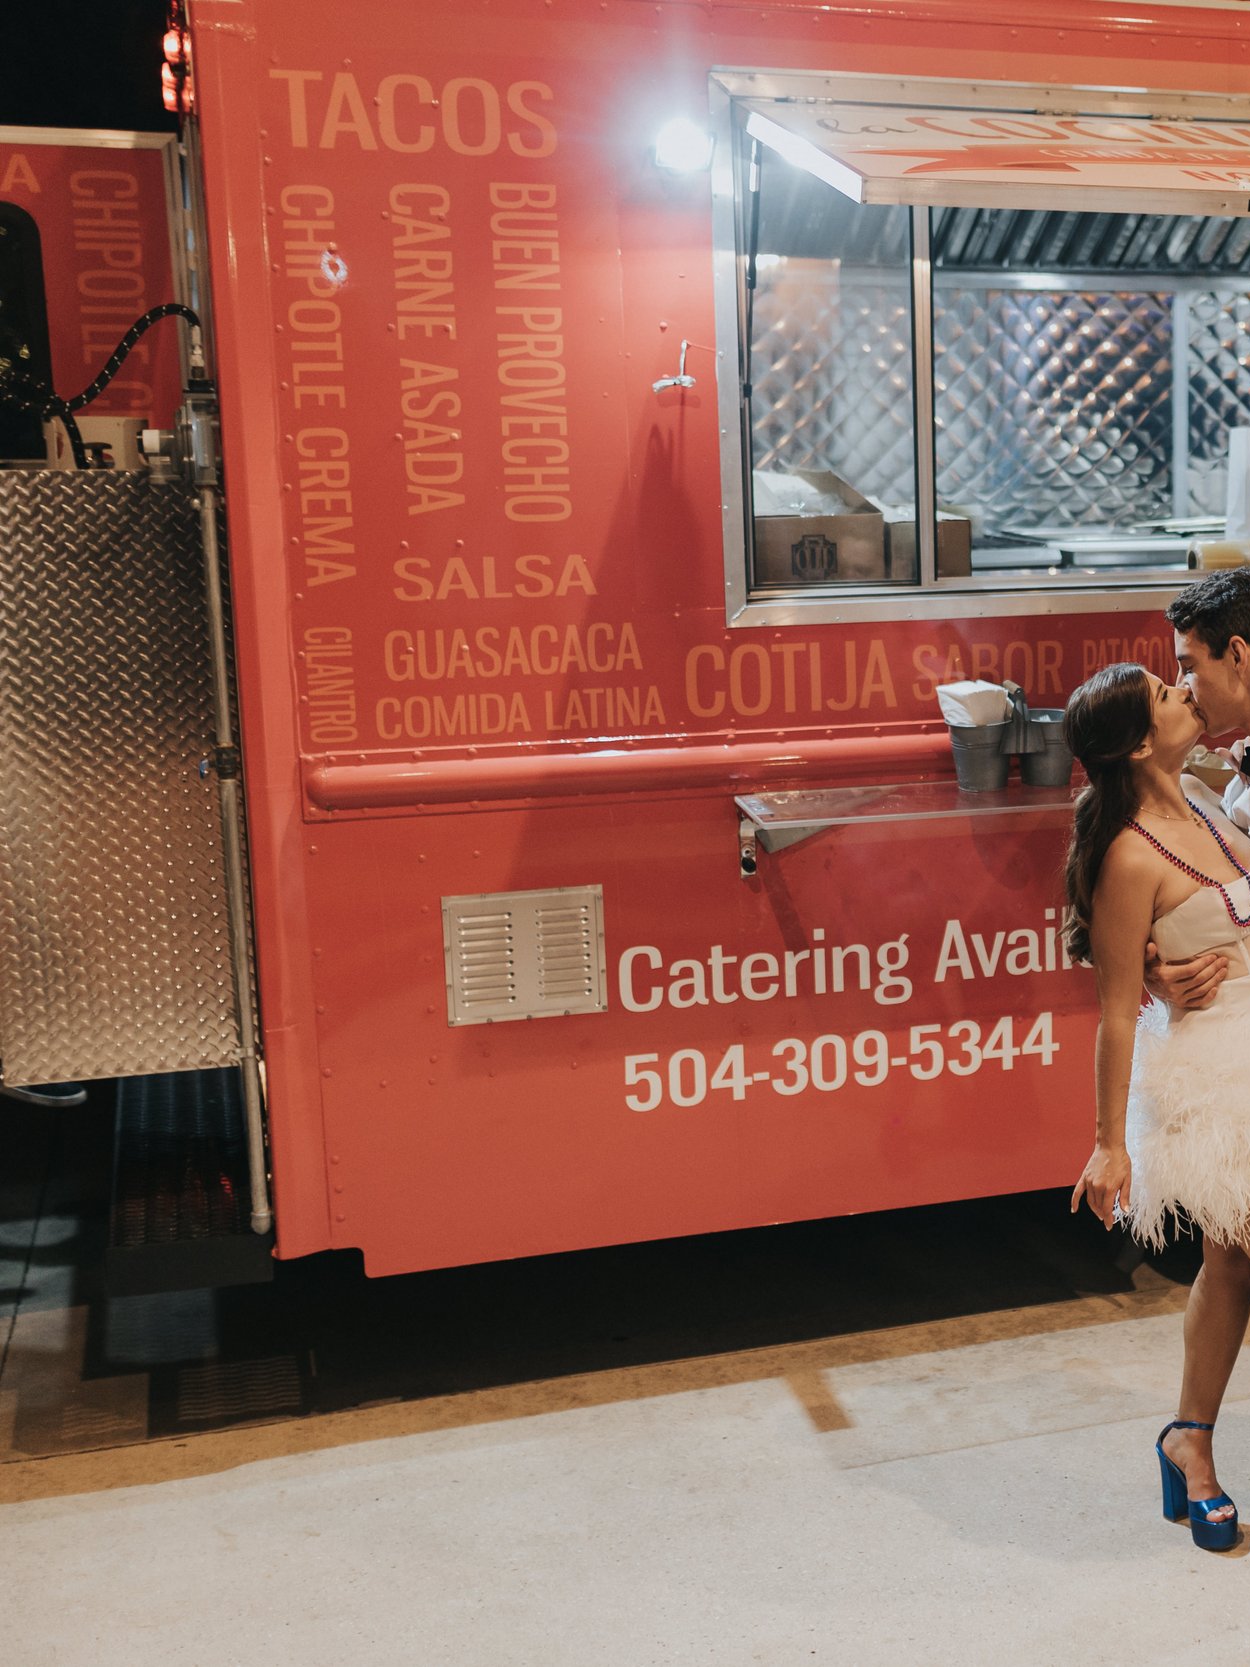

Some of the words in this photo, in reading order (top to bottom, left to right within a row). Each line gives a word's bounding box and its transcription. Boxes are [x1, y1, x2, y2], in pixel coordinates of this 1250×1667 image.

[269, 69, 558, 158] TACOS
[1186, 152, 1239, 162] DE
[388, 183, 458, 341] CARNE
[488, 182, 562, 291] BUEN
[280, 184, 346, 410] CHIPOTLE
[399, 357, 466, 516] ASADA
[495, 306, 573, 523] PROVECHO
[295, 427, 358, 588] CREMA
[392, 553, 598, 602] SALSA
[303, 626, 358, 745] CILANTRO
[384, 622, 643, 681] GUASACACA
[685, 639, 898, 717] COTIJA
[911, 640, 1065, 701] SABOR
[375, 691, 532, 740] COMIDA
[545, 685, 666, 731] LATINA
[618, 927, 914, 1013] Catering
[933, 907, 1094, 983] Avail
[623, 1010, 1061, 1112] 504-309-5344
